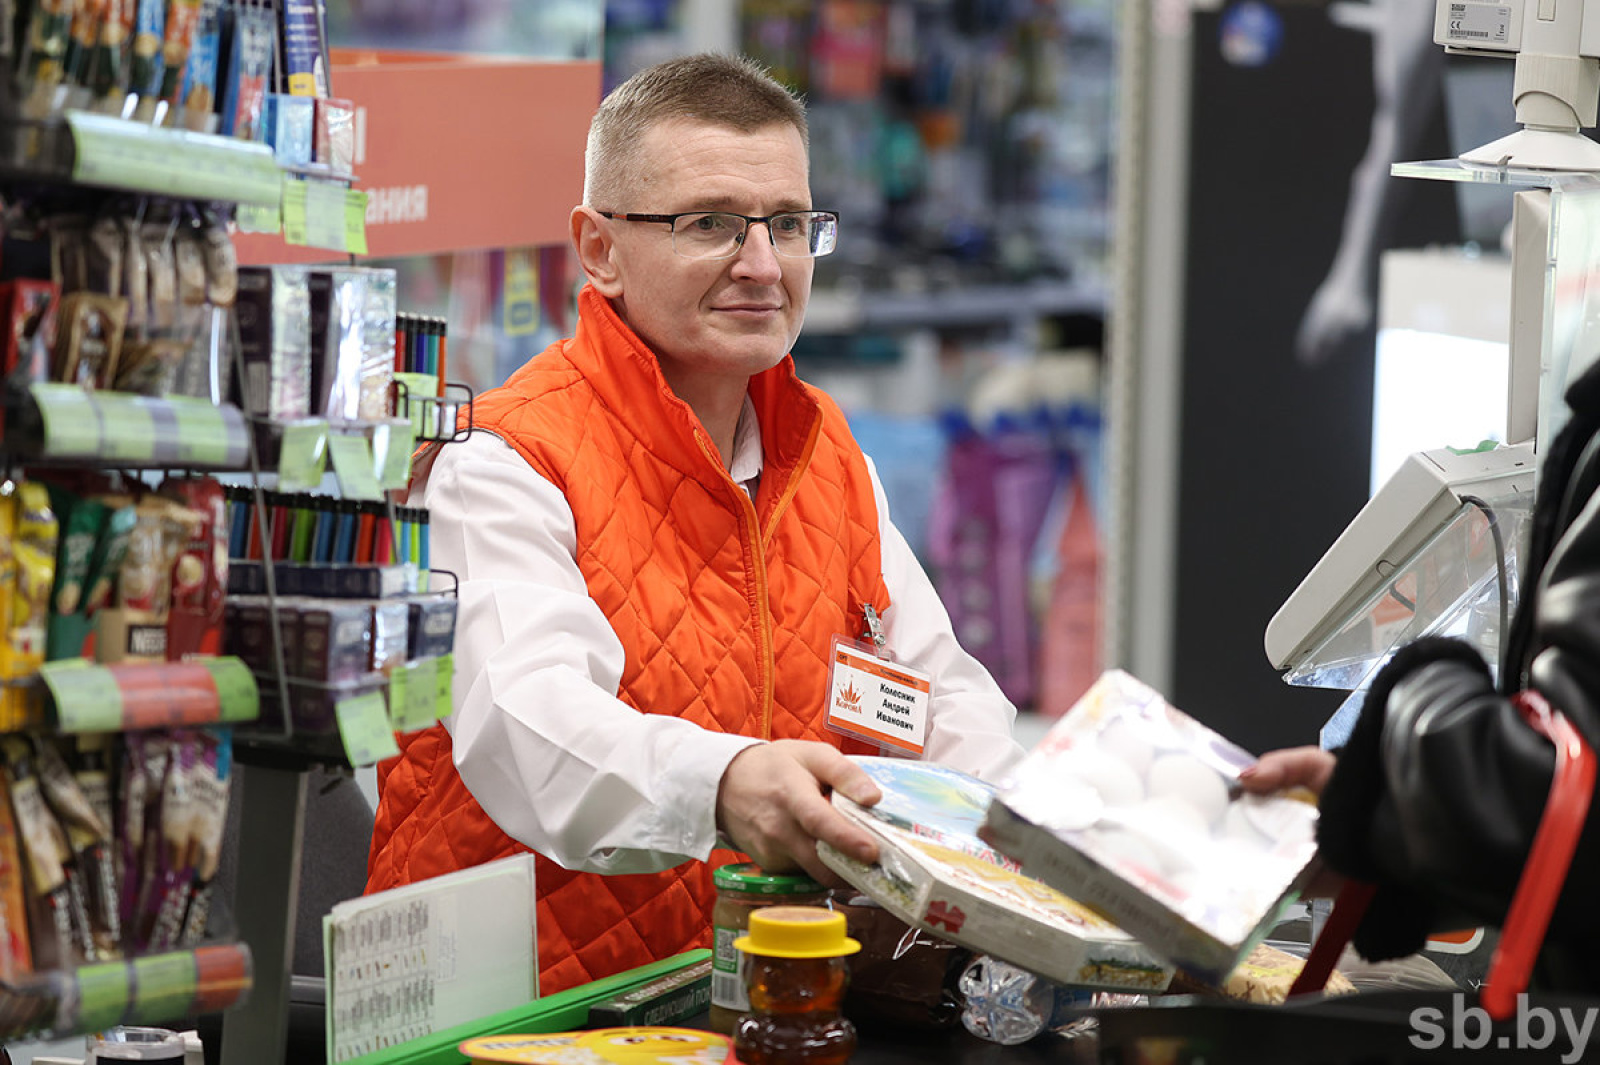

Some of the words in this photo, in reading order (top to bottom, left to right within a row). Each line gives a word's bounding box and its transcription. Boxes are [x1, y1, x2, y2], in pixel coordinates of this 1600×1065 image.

[364, 184, 427, 224] ания
[880, 683, 916, 704] Колесник
[882, 698, 911, 716] Андрей
[876, 710, 914, 731] Иванович
